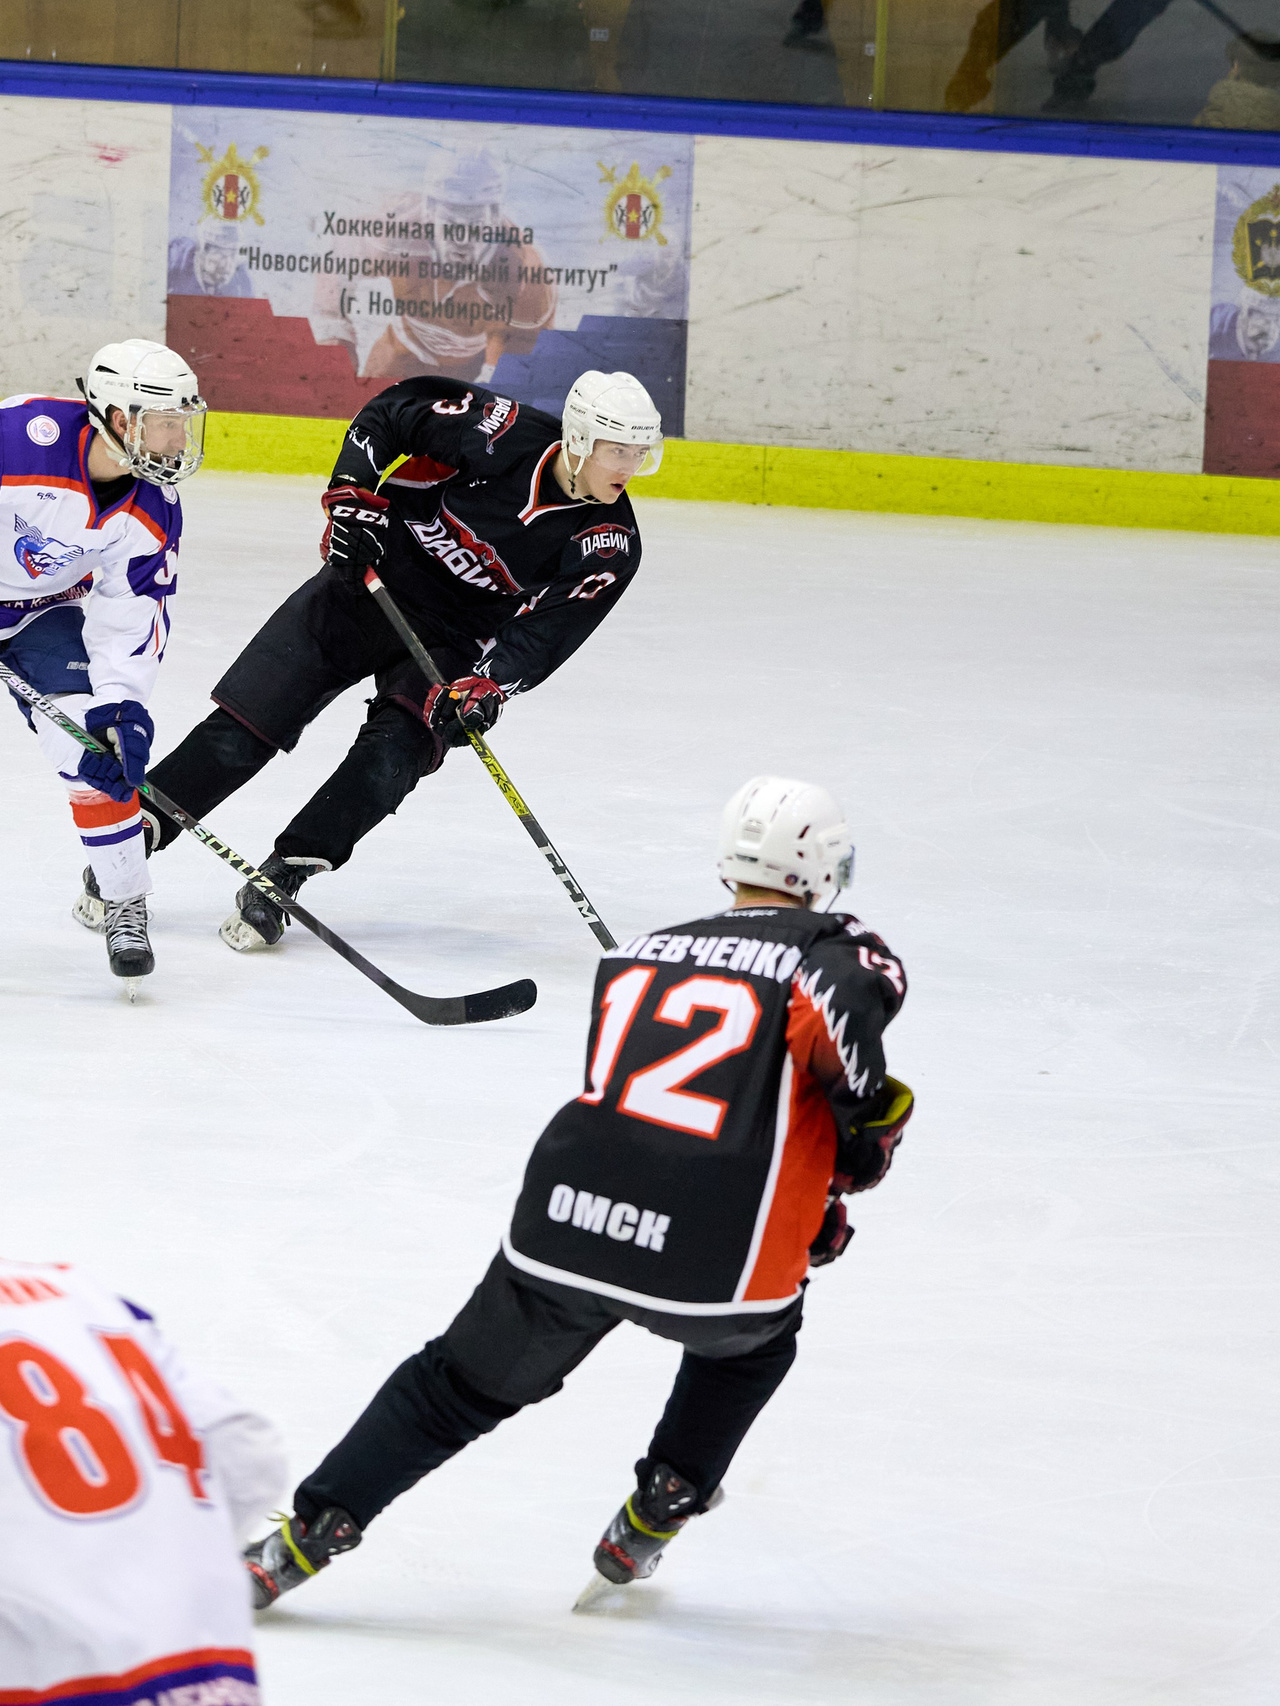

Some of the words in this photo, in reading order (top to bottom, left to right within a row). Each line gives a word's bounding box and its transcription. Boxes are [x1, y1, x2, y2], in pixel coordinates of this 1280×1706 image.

[322, 211, 435, 241] Хоккейная
[443, 223, 534, 247] команда
[418, 256, 510, 283] военный
[340, 288, 361, 318] (г.
[369, 290, 513, 326] Новосибирск)
[477, 396, 513, 435] ДАБИИ
[332, 505, 389, 528] CCM
[413, 517, 509, 596] ДАБИ
[582, 532, 629, 557] ДАБИИ
[190, 824, 275, 892] SOYUZ
[578, 964, 763, 1141] 12
[547, 1183, 672, 1254] ОМСК
